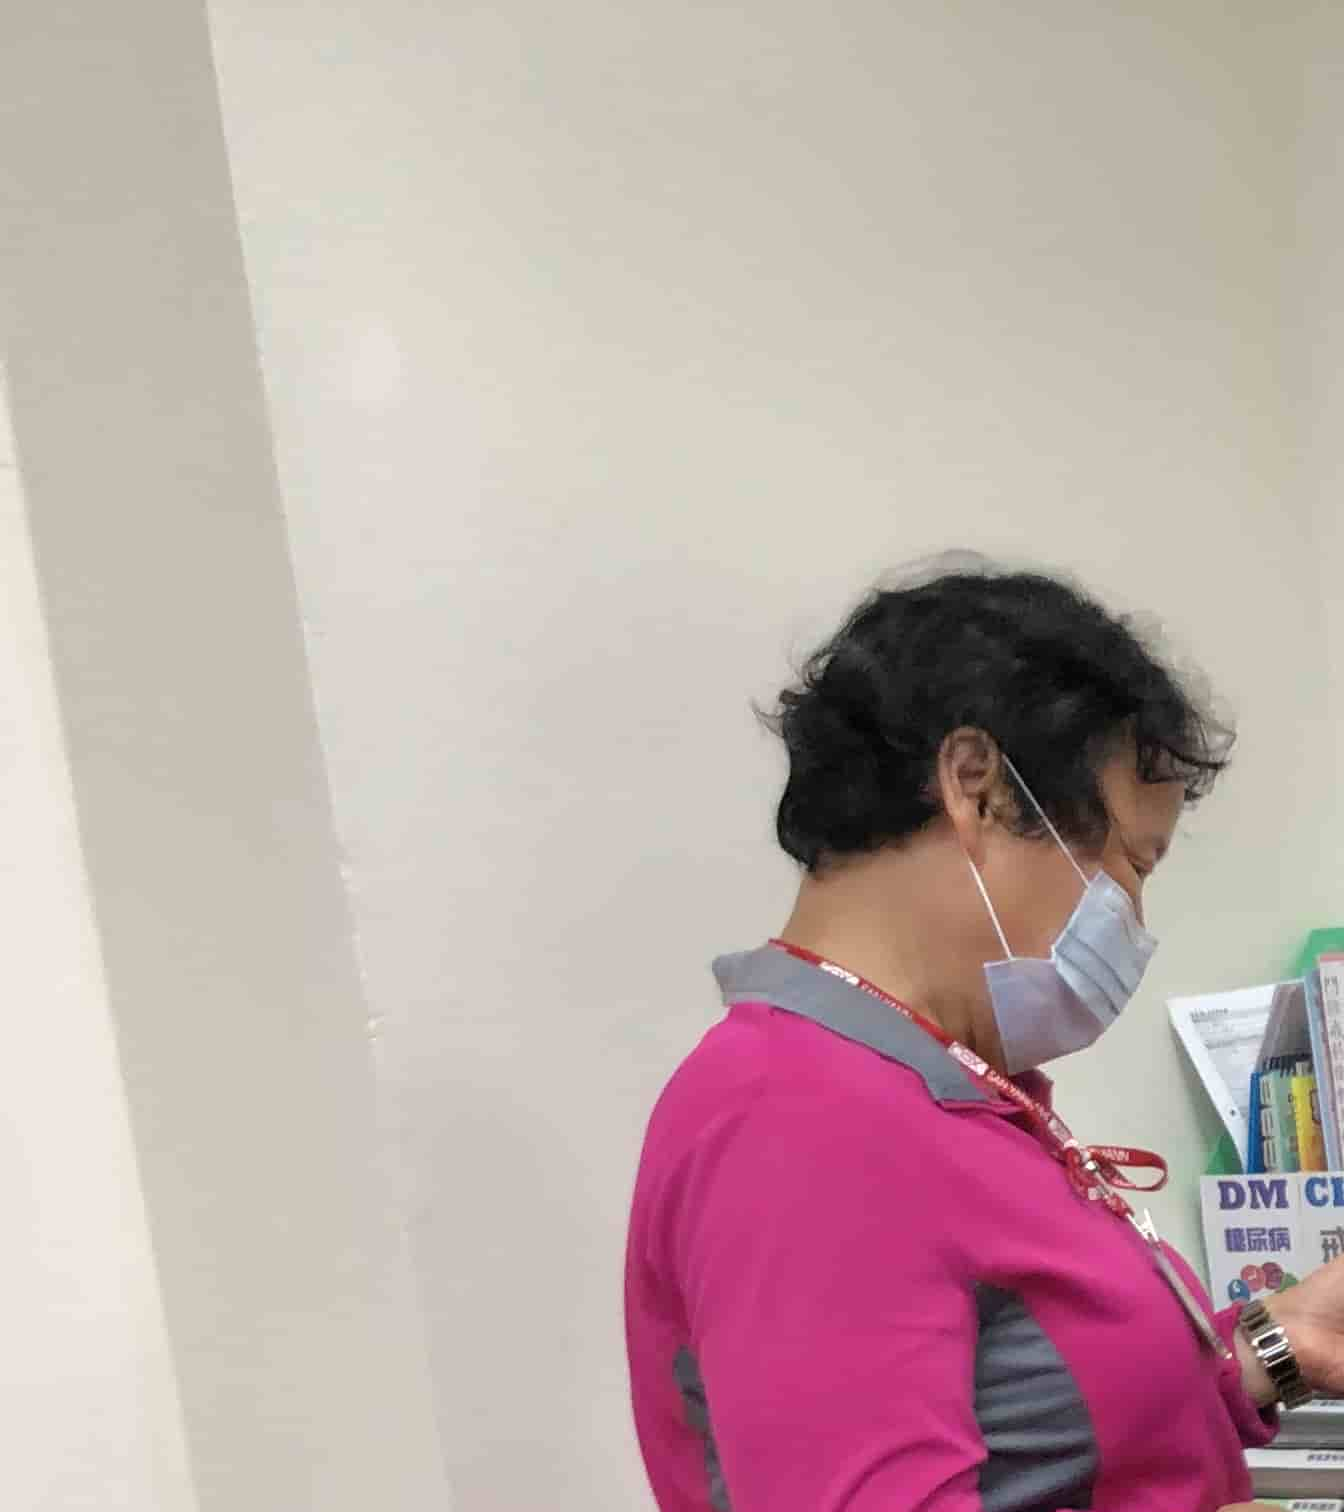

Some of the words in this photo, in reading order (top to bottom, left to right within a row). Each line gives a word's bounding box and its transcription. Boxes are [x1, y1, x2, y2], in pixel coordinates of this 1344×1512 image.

[1218, 1179, 1290, 1210] DM
[1224, 1226, 1291, 1252] 糖尿病
